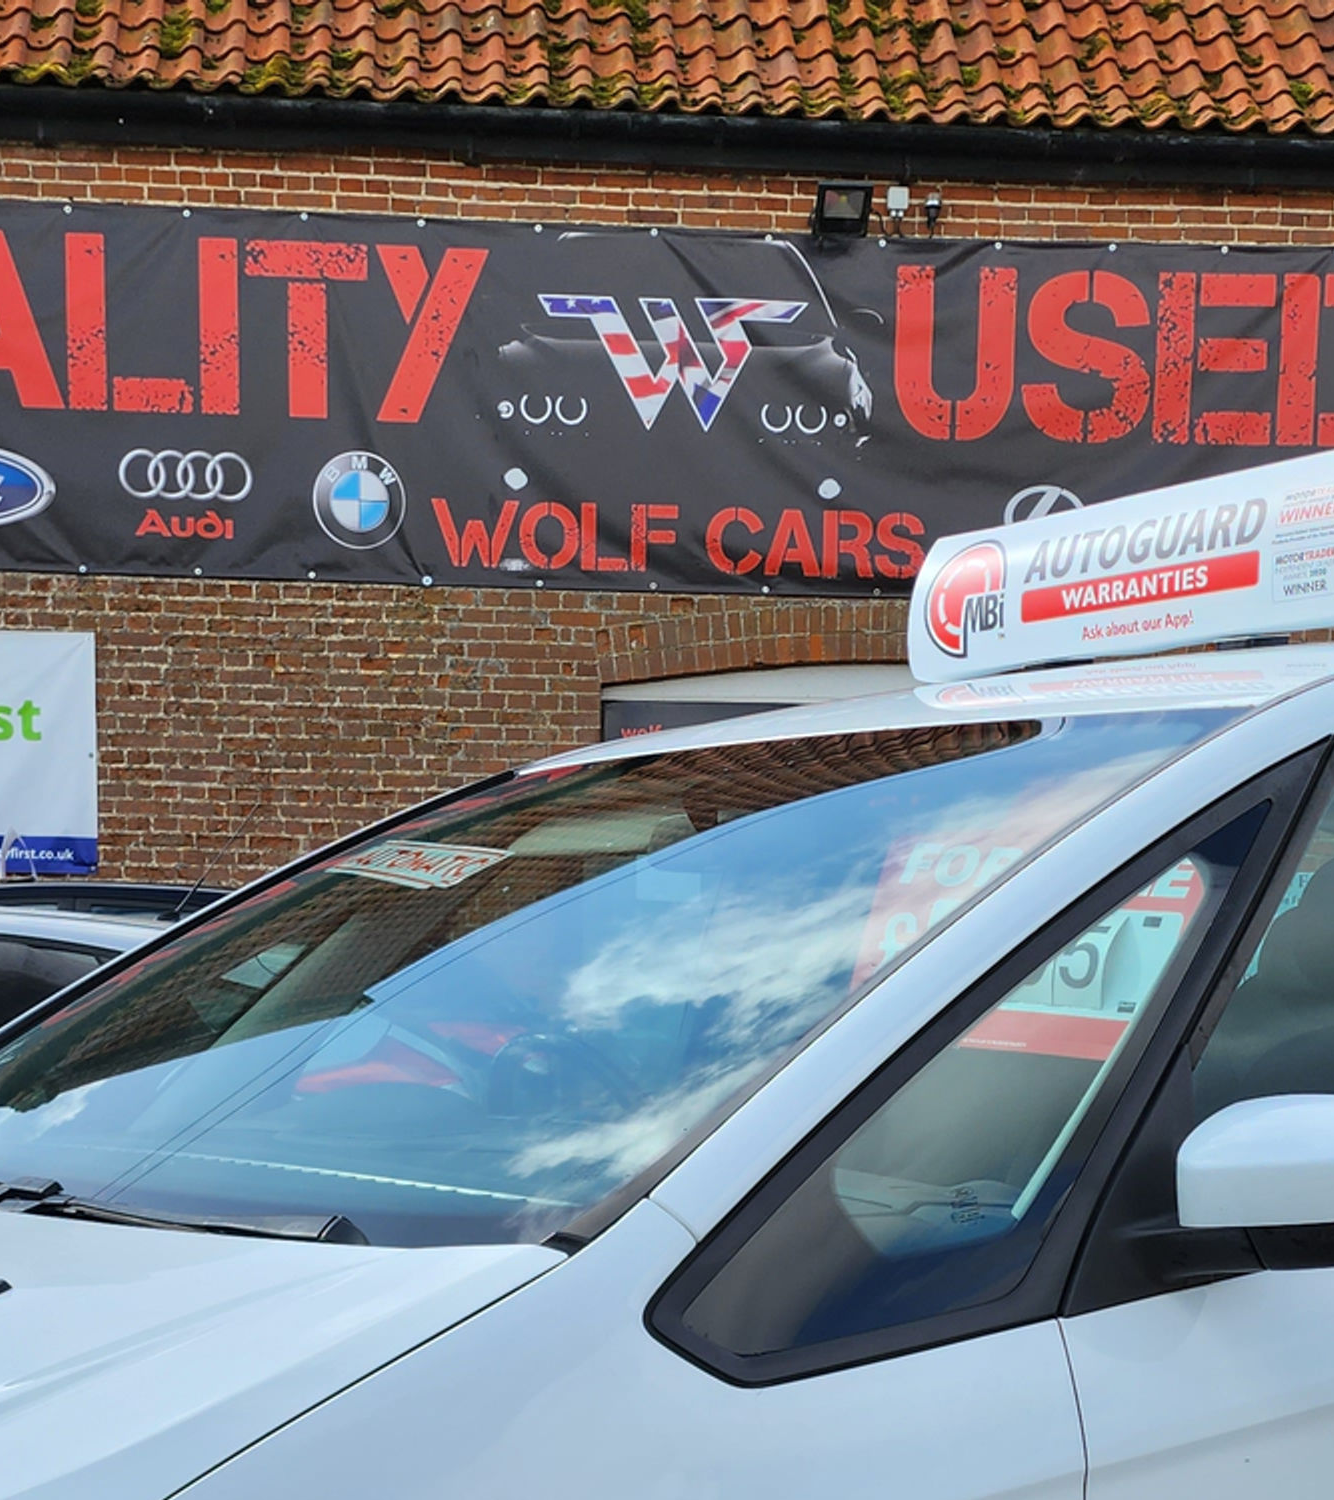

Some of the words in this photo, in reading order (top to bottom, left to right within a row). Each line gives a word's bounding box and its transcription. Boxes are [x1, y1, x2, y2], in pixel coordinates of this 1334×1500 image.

[323, 455, 398, 487] BMW
[134, 508, 235, 541] Audi
[431, 497, 679, 572] WOLF
[705, 506, 927, 579] CARS
[1023, 497, 1268, 585] AUTOGUARD
[1060, 565, 1209, 610] WARRANTIES
[1282, 578, 1328, 597] WINNER
[1081, 625, 1104, 641] Ask
[1105, 620, 1141, 637] about
[1142, 618, 1162, 632] our
[1164, 609, 1195, 630] App!
